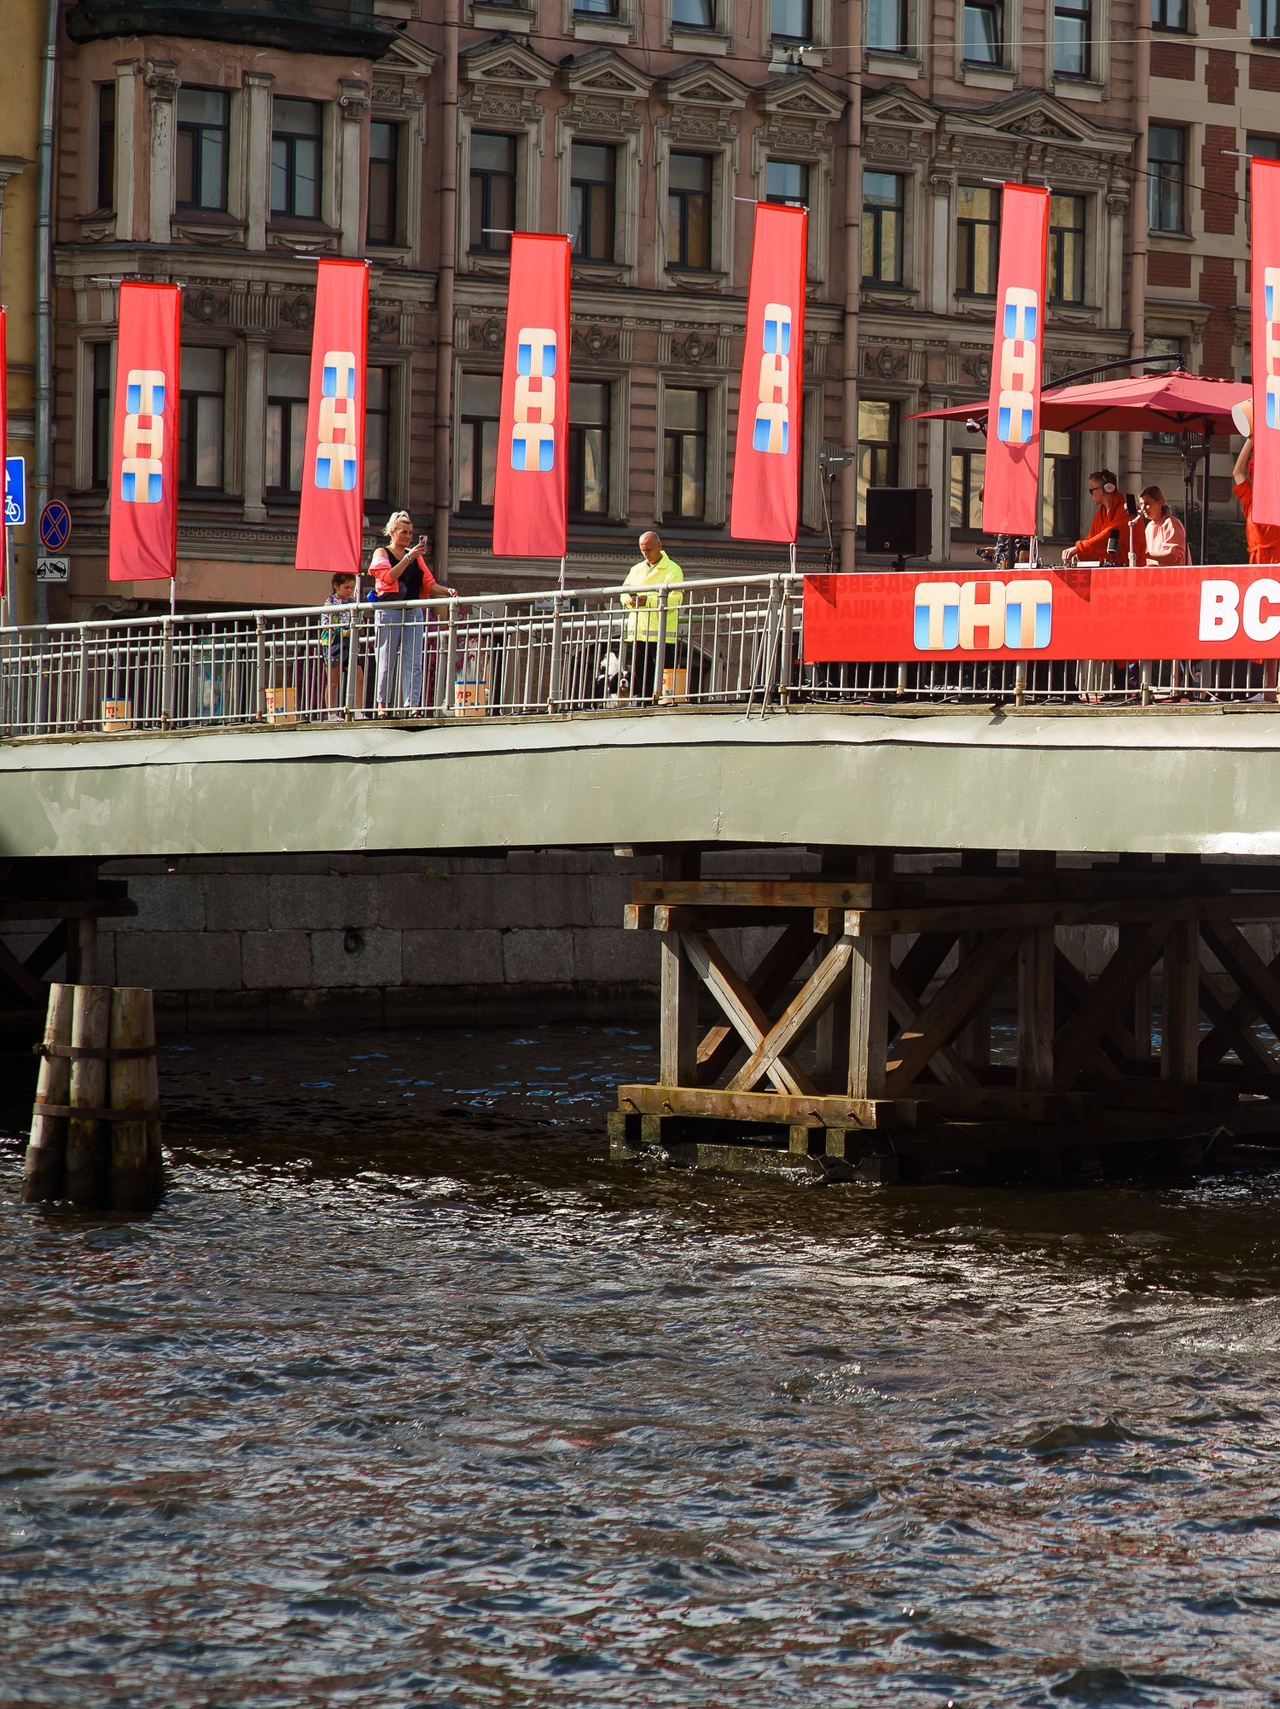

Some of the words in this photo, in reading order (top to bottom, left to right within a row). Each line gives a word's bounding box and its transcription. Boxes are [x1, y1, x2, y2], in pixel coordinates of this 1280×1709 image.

[314, 350, 357, 490] ТНТ
[511, 327, 557, 472] ТНТ
[752, 302, 792, 455] ТНТ
[997, 286, 1038, 443] ТНТ
[121, 369, 166, 503] ТНТ
[913, 580, 1053, 650] ТНТ
